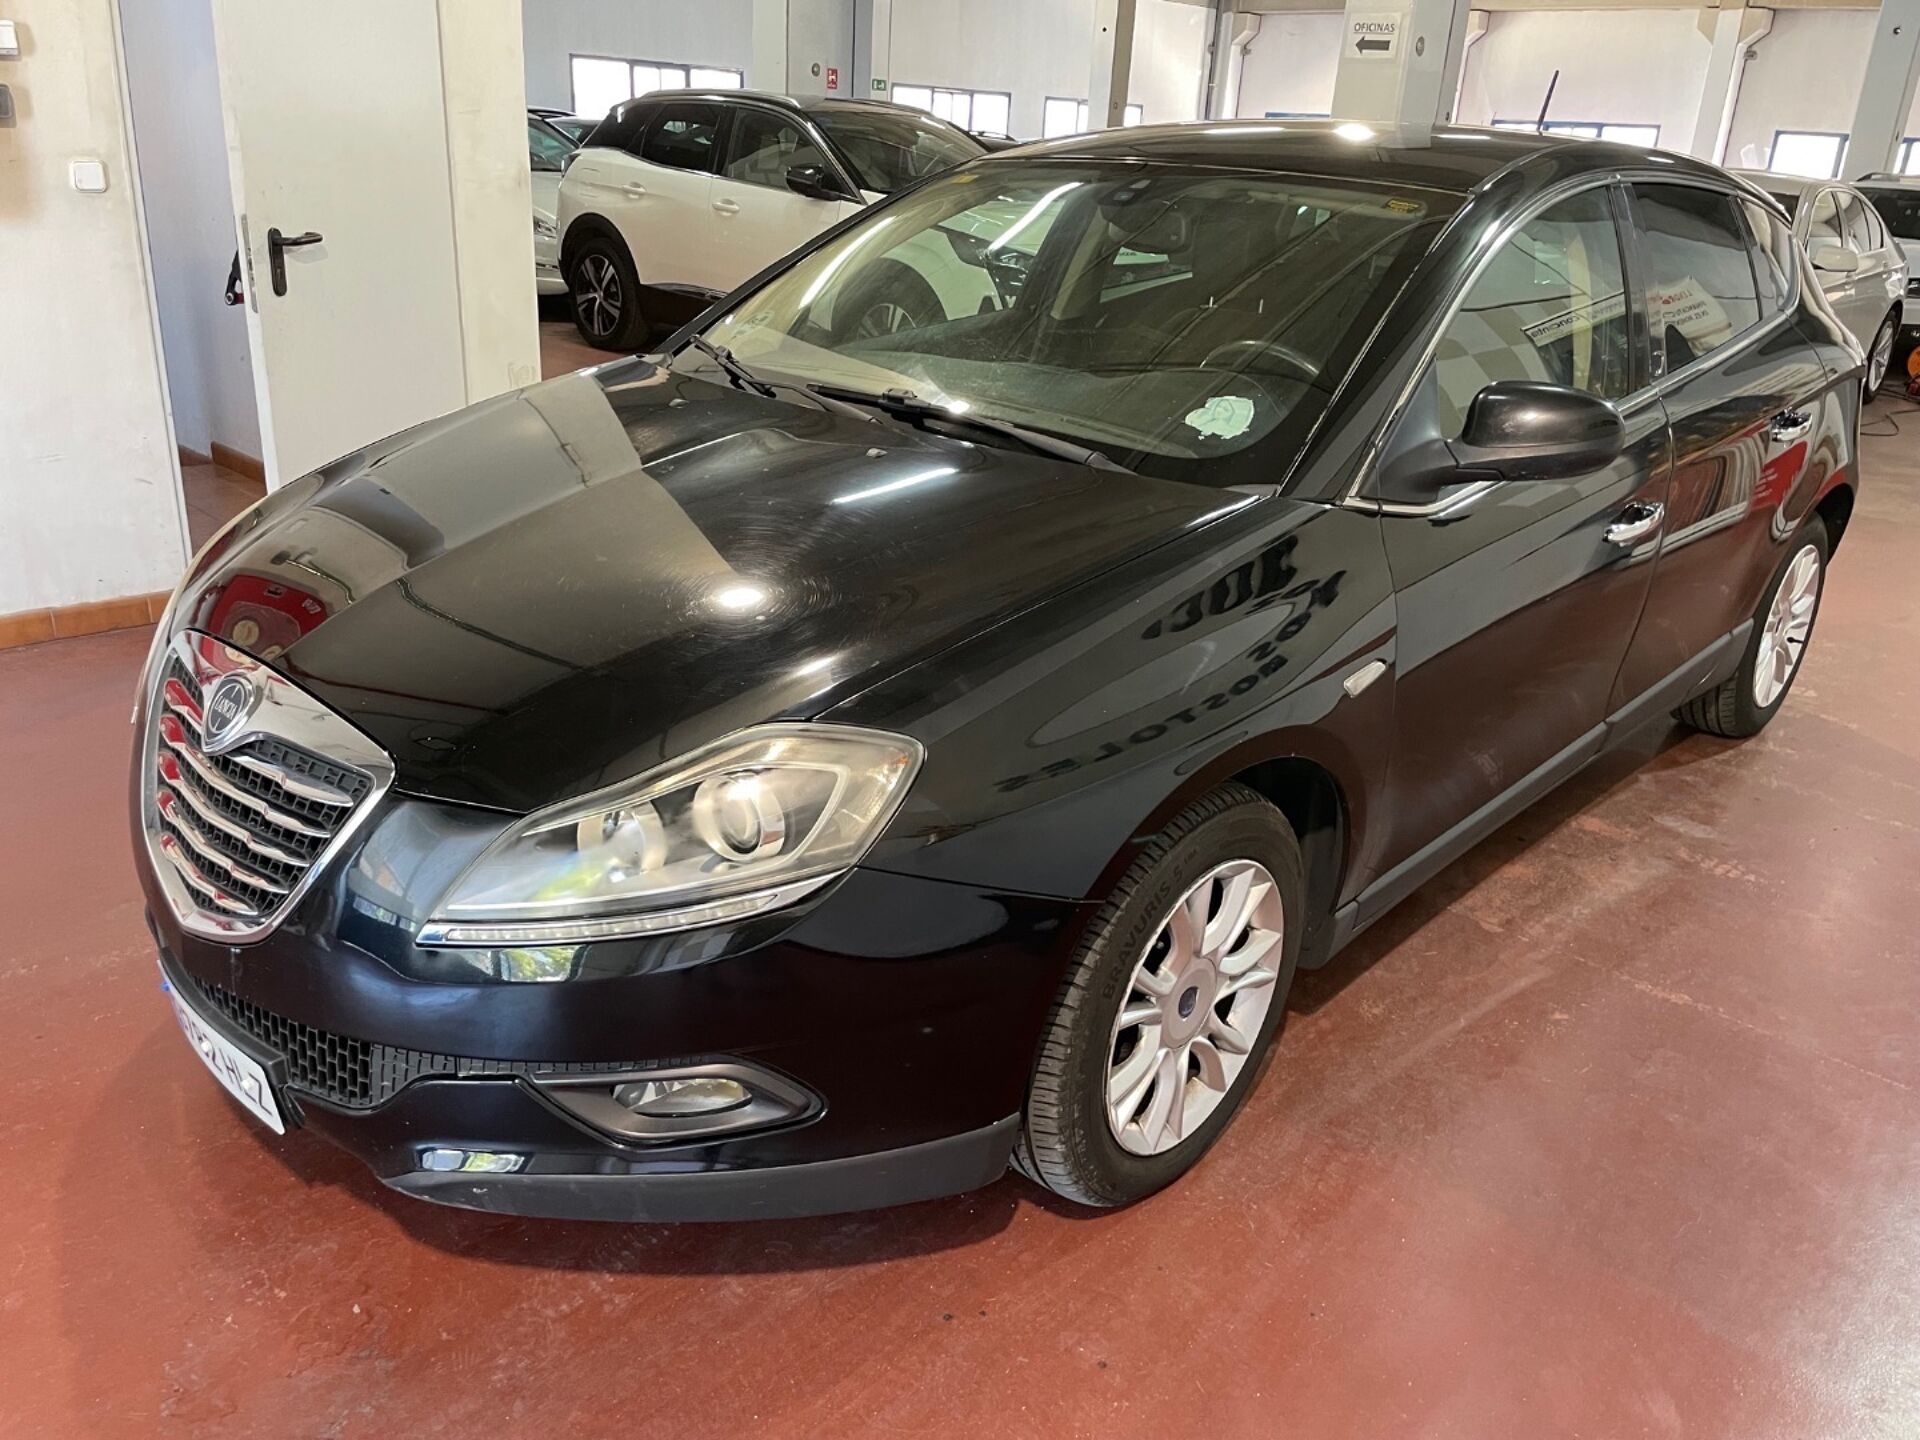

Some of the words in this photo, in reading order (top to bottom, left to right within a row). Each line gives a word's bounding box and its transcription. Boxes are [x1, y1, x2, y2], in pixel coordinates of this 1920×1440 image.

[1353, 22, 1396, 33] OFICINAS
[214, 695, 239, 721] LANCIA
[1102, 880, 1172, 1000] BRAVURIS
